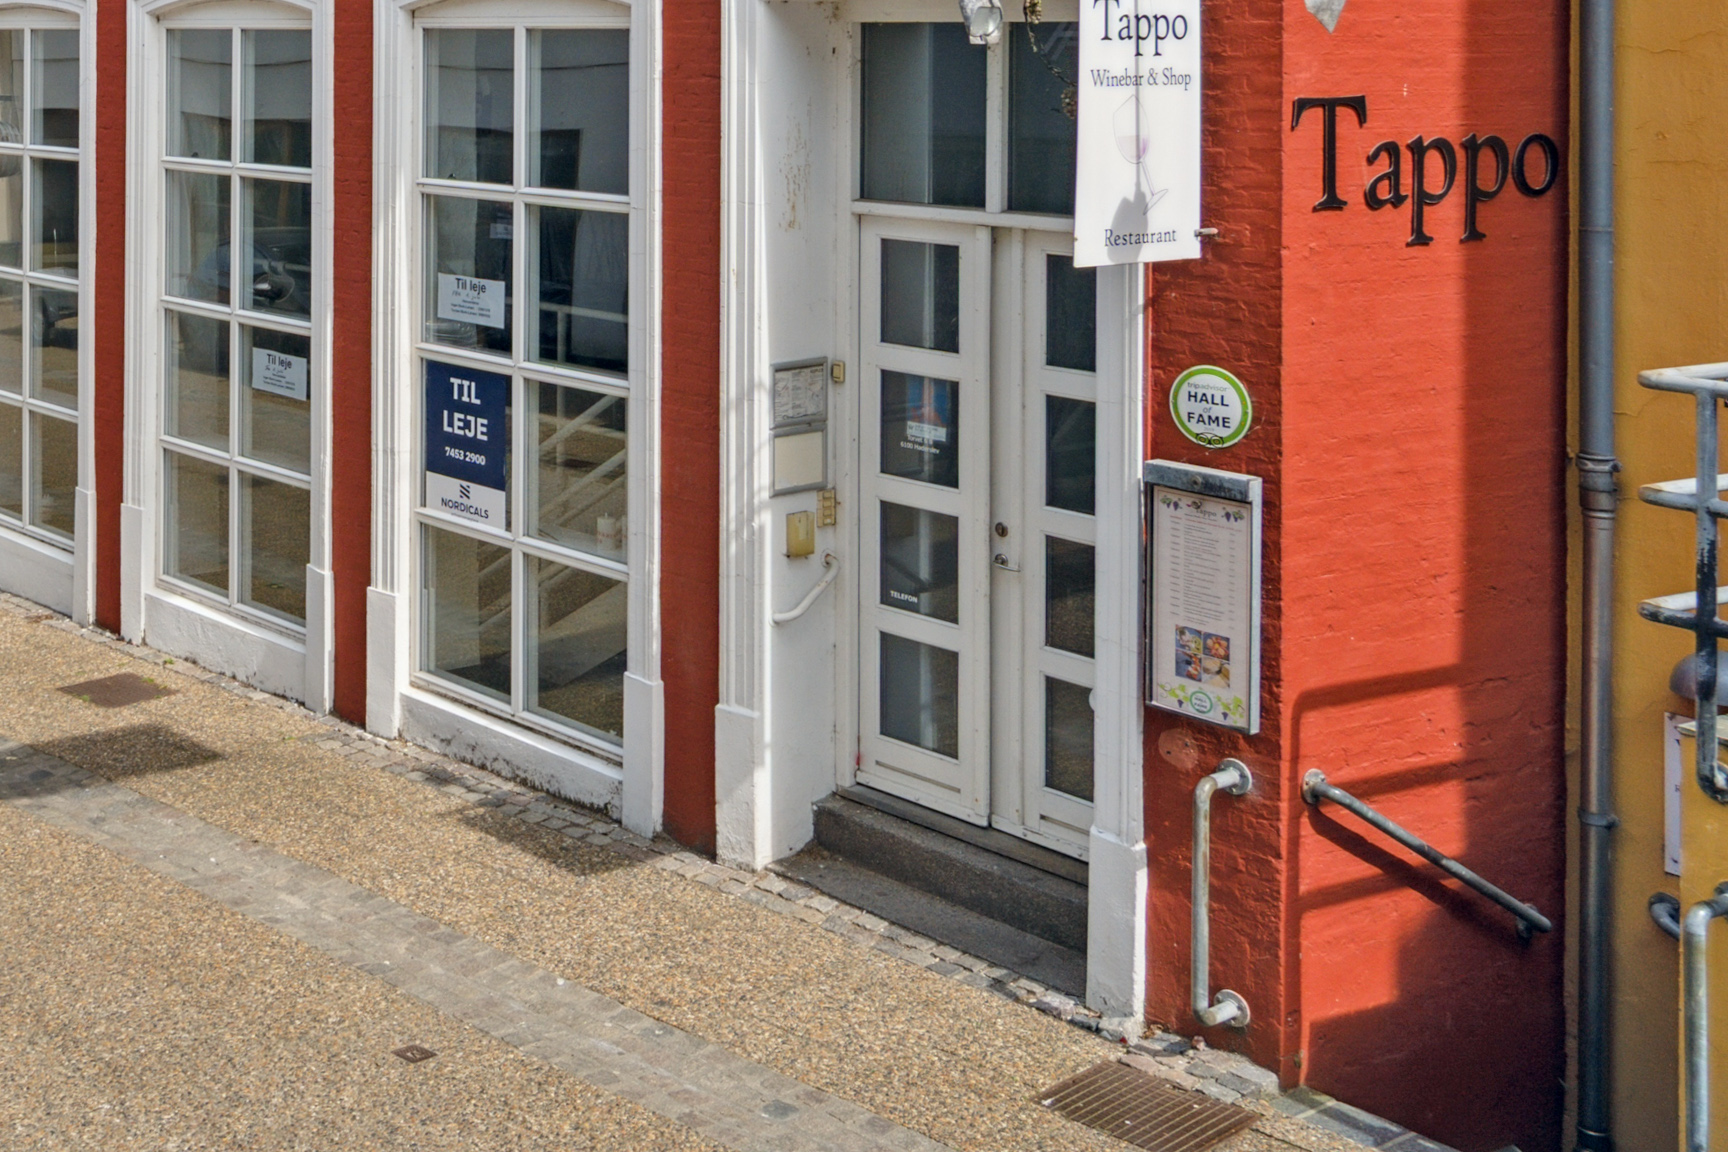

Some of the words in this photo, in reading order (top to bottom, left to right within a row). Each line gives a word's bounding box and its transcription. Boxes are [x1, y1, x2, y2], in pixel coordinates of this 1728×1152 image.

[1091, 68, 1145, 88] Winebar
[1147, 71, 1159, 86] &
[1162, 70, 1192, 92] Shop
[1291, 95, 1560, 247] Tappo
[1104, 229, 1177, 248] Restaurant
[455, 277, 467, 290] Til
[469, 280, 487, 295] leje
[267, 353, 276, 366] Til
[278, 356, 293, 370] leje
[450, 377, 481, 405] TIL
[1187, 381, 1229, 392] tripadvisor
[1187, 390, 1230, 407] HALL
[443, 410, 489, 442] LEJE
[1187, 411, 1231, 429] FAME
[445, 446, 465, 460] 7453
[465, 451, 486, 466] 2900
[441, 497, 489, 519] NORDICALS
[890, 590, 918, 604] TELEFON
